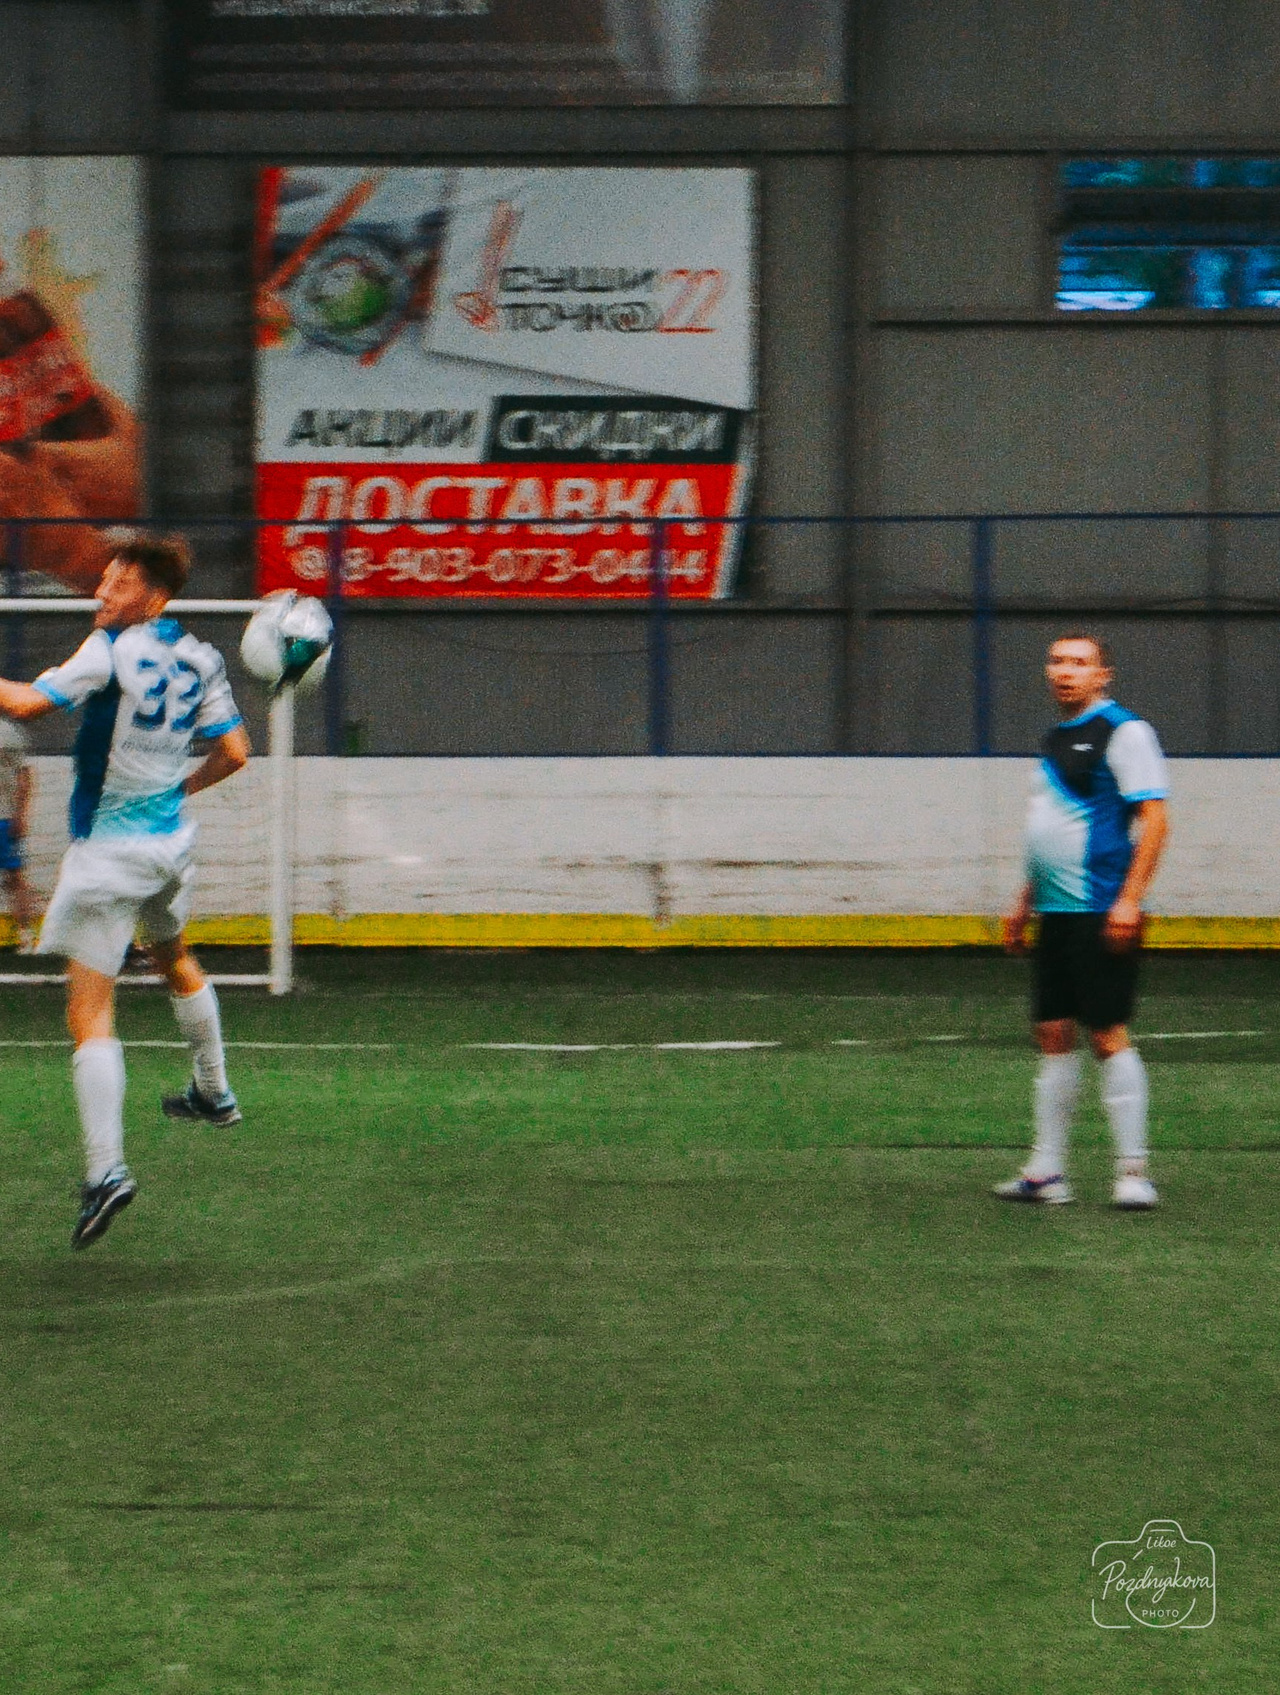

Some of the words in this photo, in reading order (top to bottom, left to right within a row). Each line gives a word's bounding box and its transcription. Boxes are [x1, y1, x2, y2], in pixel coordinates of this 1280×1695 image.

[499, 266, 658, 293] СУШИ
[658, 267, 728, 333] 22
[284, 409, 480, 456] АКЦИИ
[497, 409, 724, 459] СКИДКИ
[282, 476, 707, 546] ДОСТАВКА
